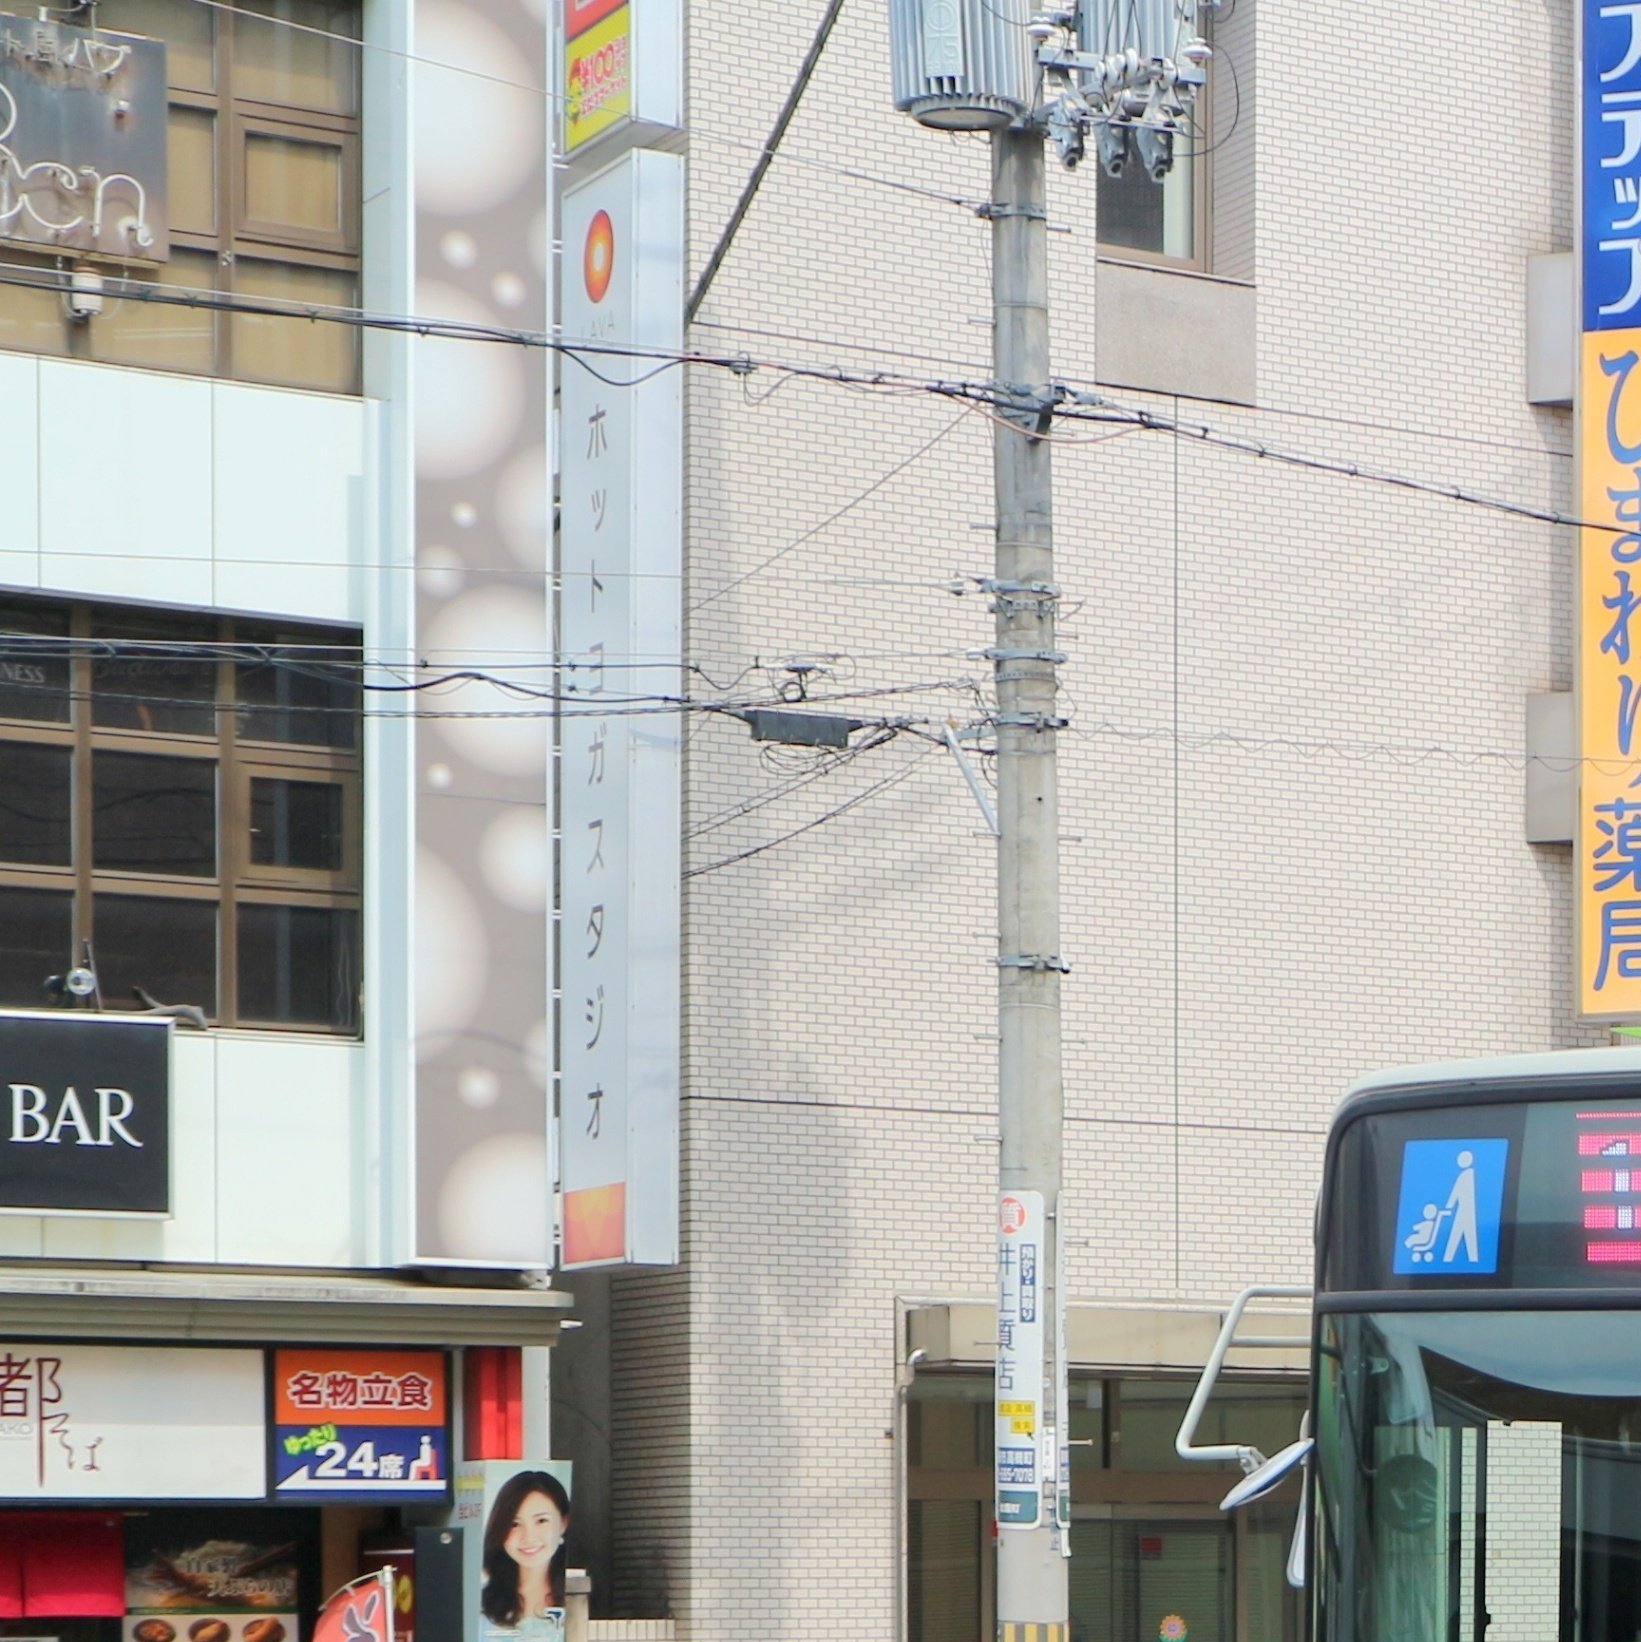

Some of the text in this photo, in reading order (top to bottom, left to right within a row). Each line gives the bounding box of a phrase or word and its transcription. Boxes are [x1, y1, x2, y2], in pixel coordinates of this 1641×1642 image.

[10, 1083, 144, 1149] BAR
[286, 1370, 432, 1411] 名物立食
[314, 1440, 406, 1480] 24席
